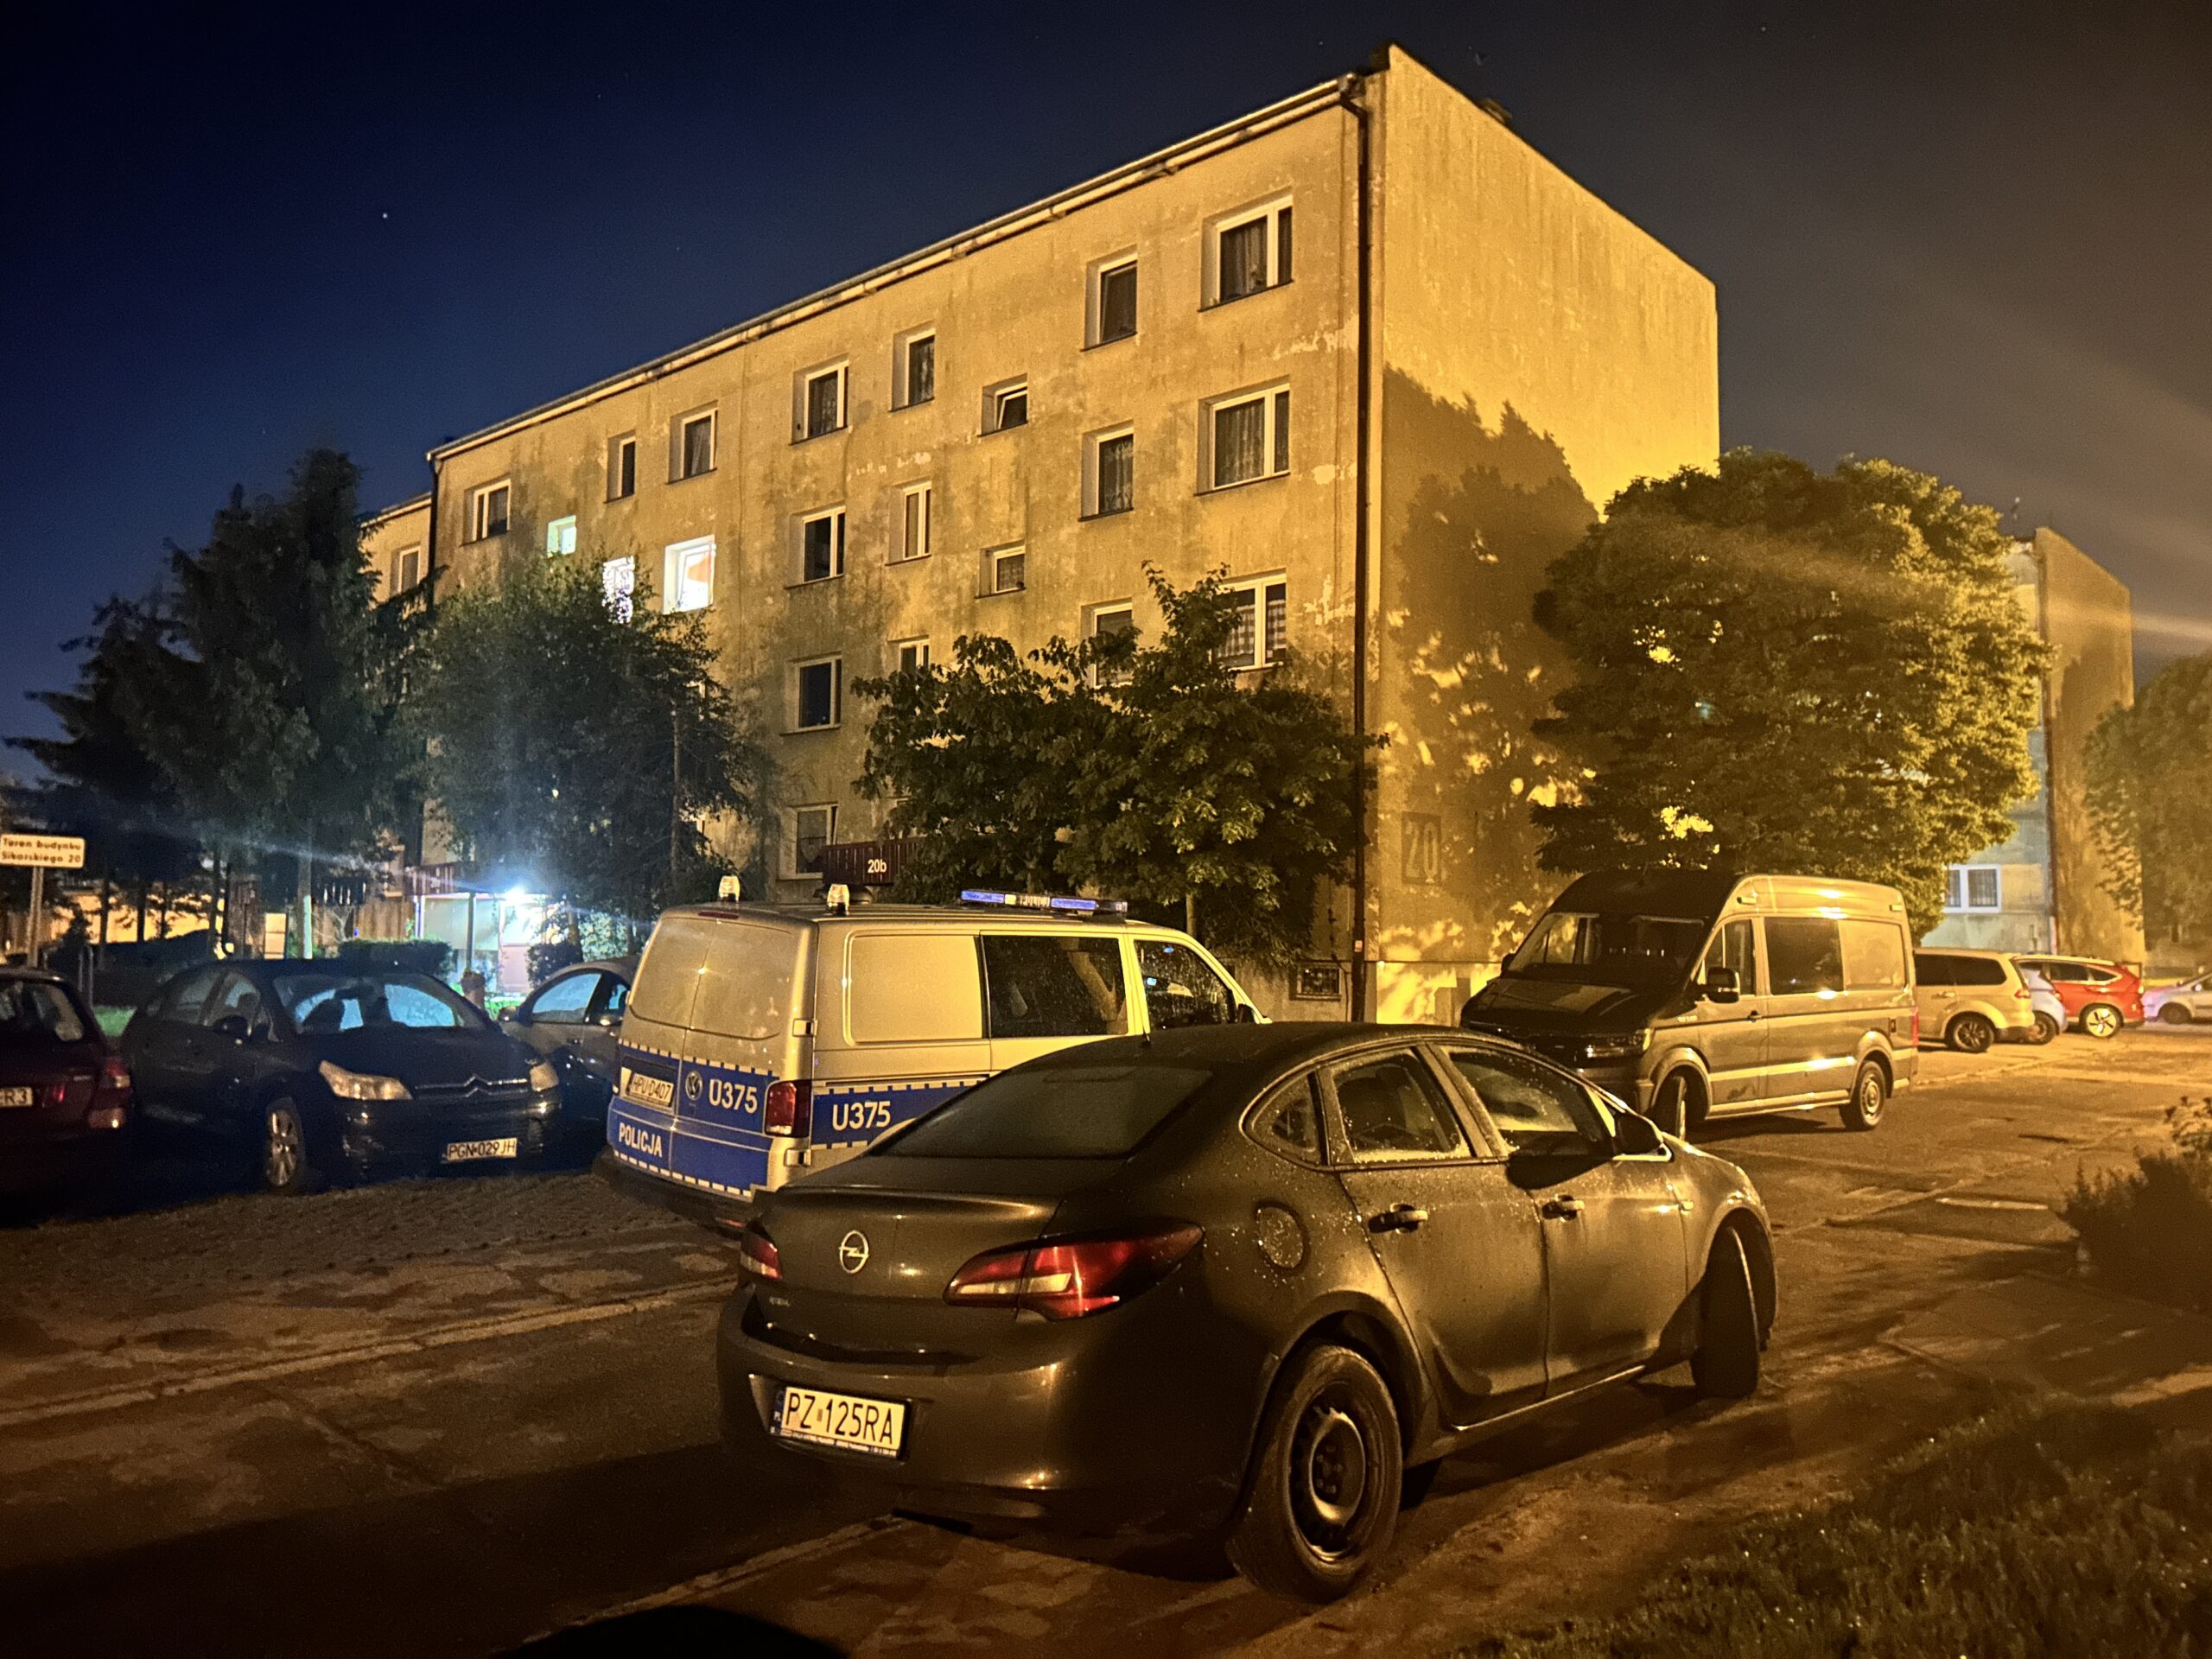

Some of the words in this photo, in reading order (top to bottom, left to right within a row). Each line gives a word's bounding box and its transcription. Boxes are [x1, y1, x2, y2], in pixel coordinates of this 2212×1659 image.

[36, 840, 81, 851] budynku
[868, 859, 887, 874] 20b
[0, 1088, 28, 1104] R3
[709, 1078, 758, 1115] U375
[832, 1100, 891, 1131] U375
[448, 1144, 475, 1159] PGN
[619, 1122, 663, 1158] POLICJA
[785, 1392, 817, 1429] PZ
[826, 1398, 893, 1445] 125RA
